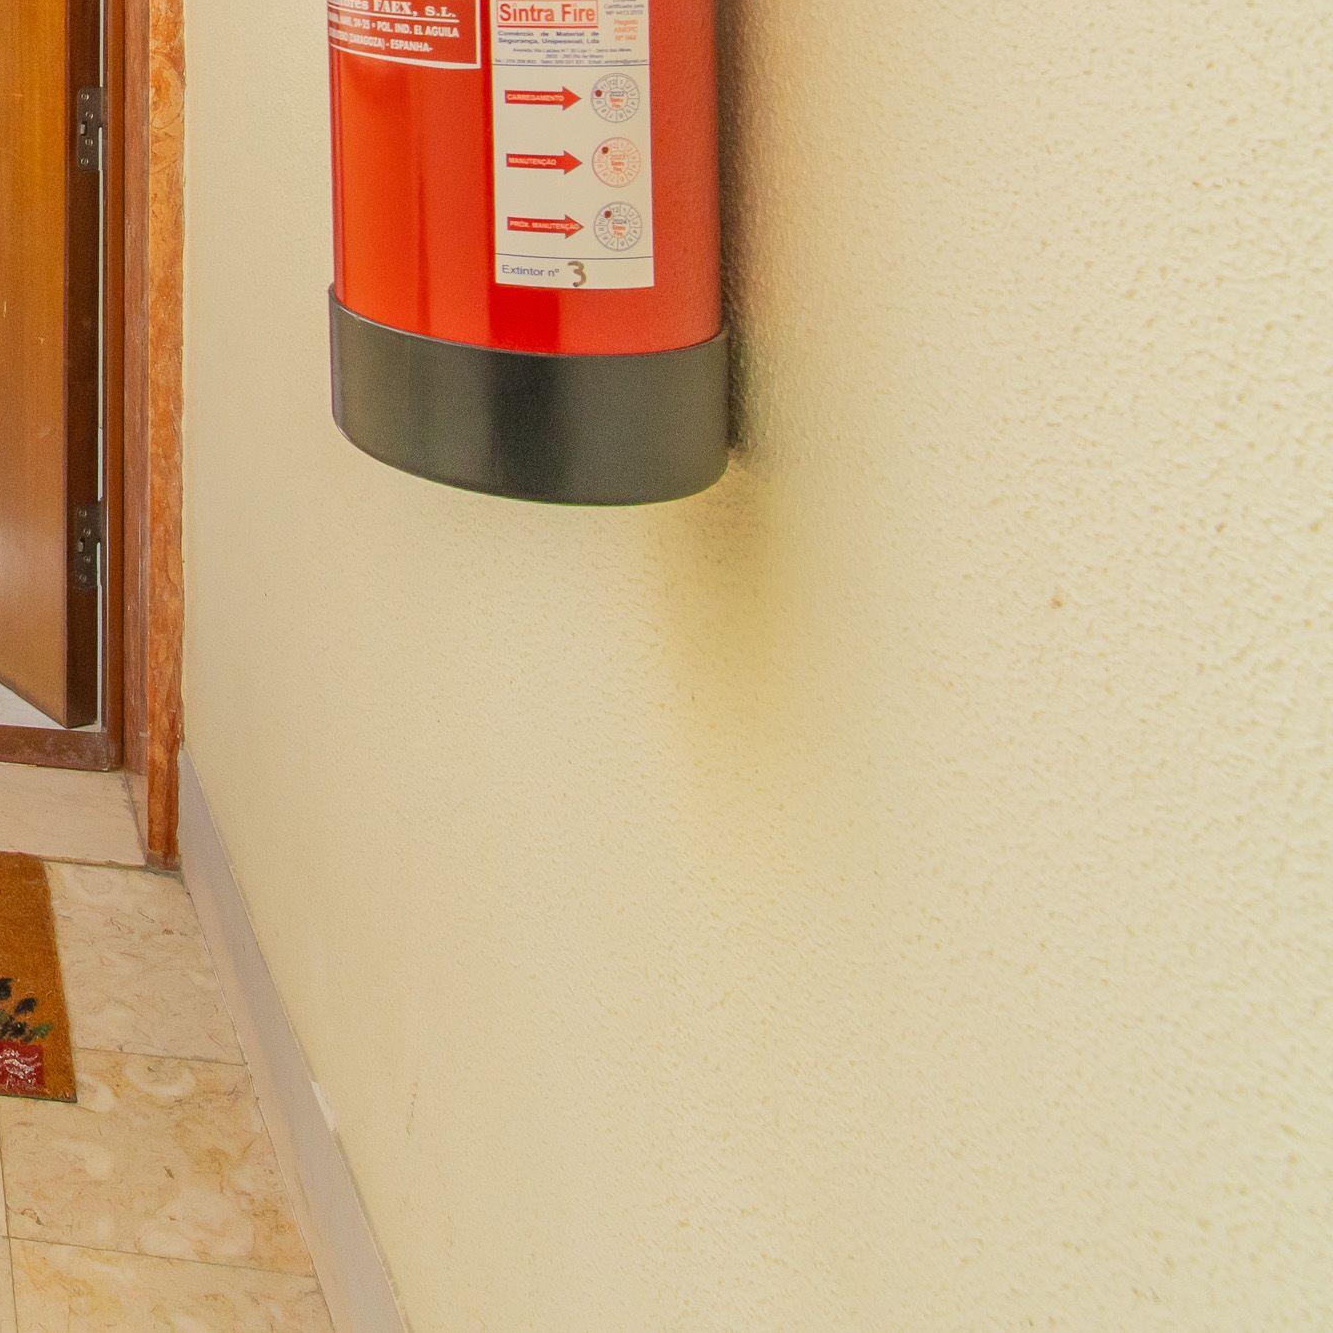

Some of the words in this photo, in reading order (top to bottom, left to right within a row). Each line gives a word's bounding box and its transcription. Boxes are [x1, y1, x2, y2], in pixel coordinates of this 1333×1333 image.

[373, 0, 418, 17] FAEX,
[425, 6, 457, 18] S.L.
[499, 3, 555, 22] Sintra
[561, 3, 596, 22] Fire
[395, 23, 412, 35] IND.
[414, 24, 424, 36] EL
[425, 25, 460, 38] AGUILA
[507, 93, 565, 102] CARREGAMENTO
[508, 157, 557, 167] MANUTENÇÃO
[501, 264, 544, 277] Extintor
[548, 268, 560, 277] nº
[567, 260, 587, 288] 3
